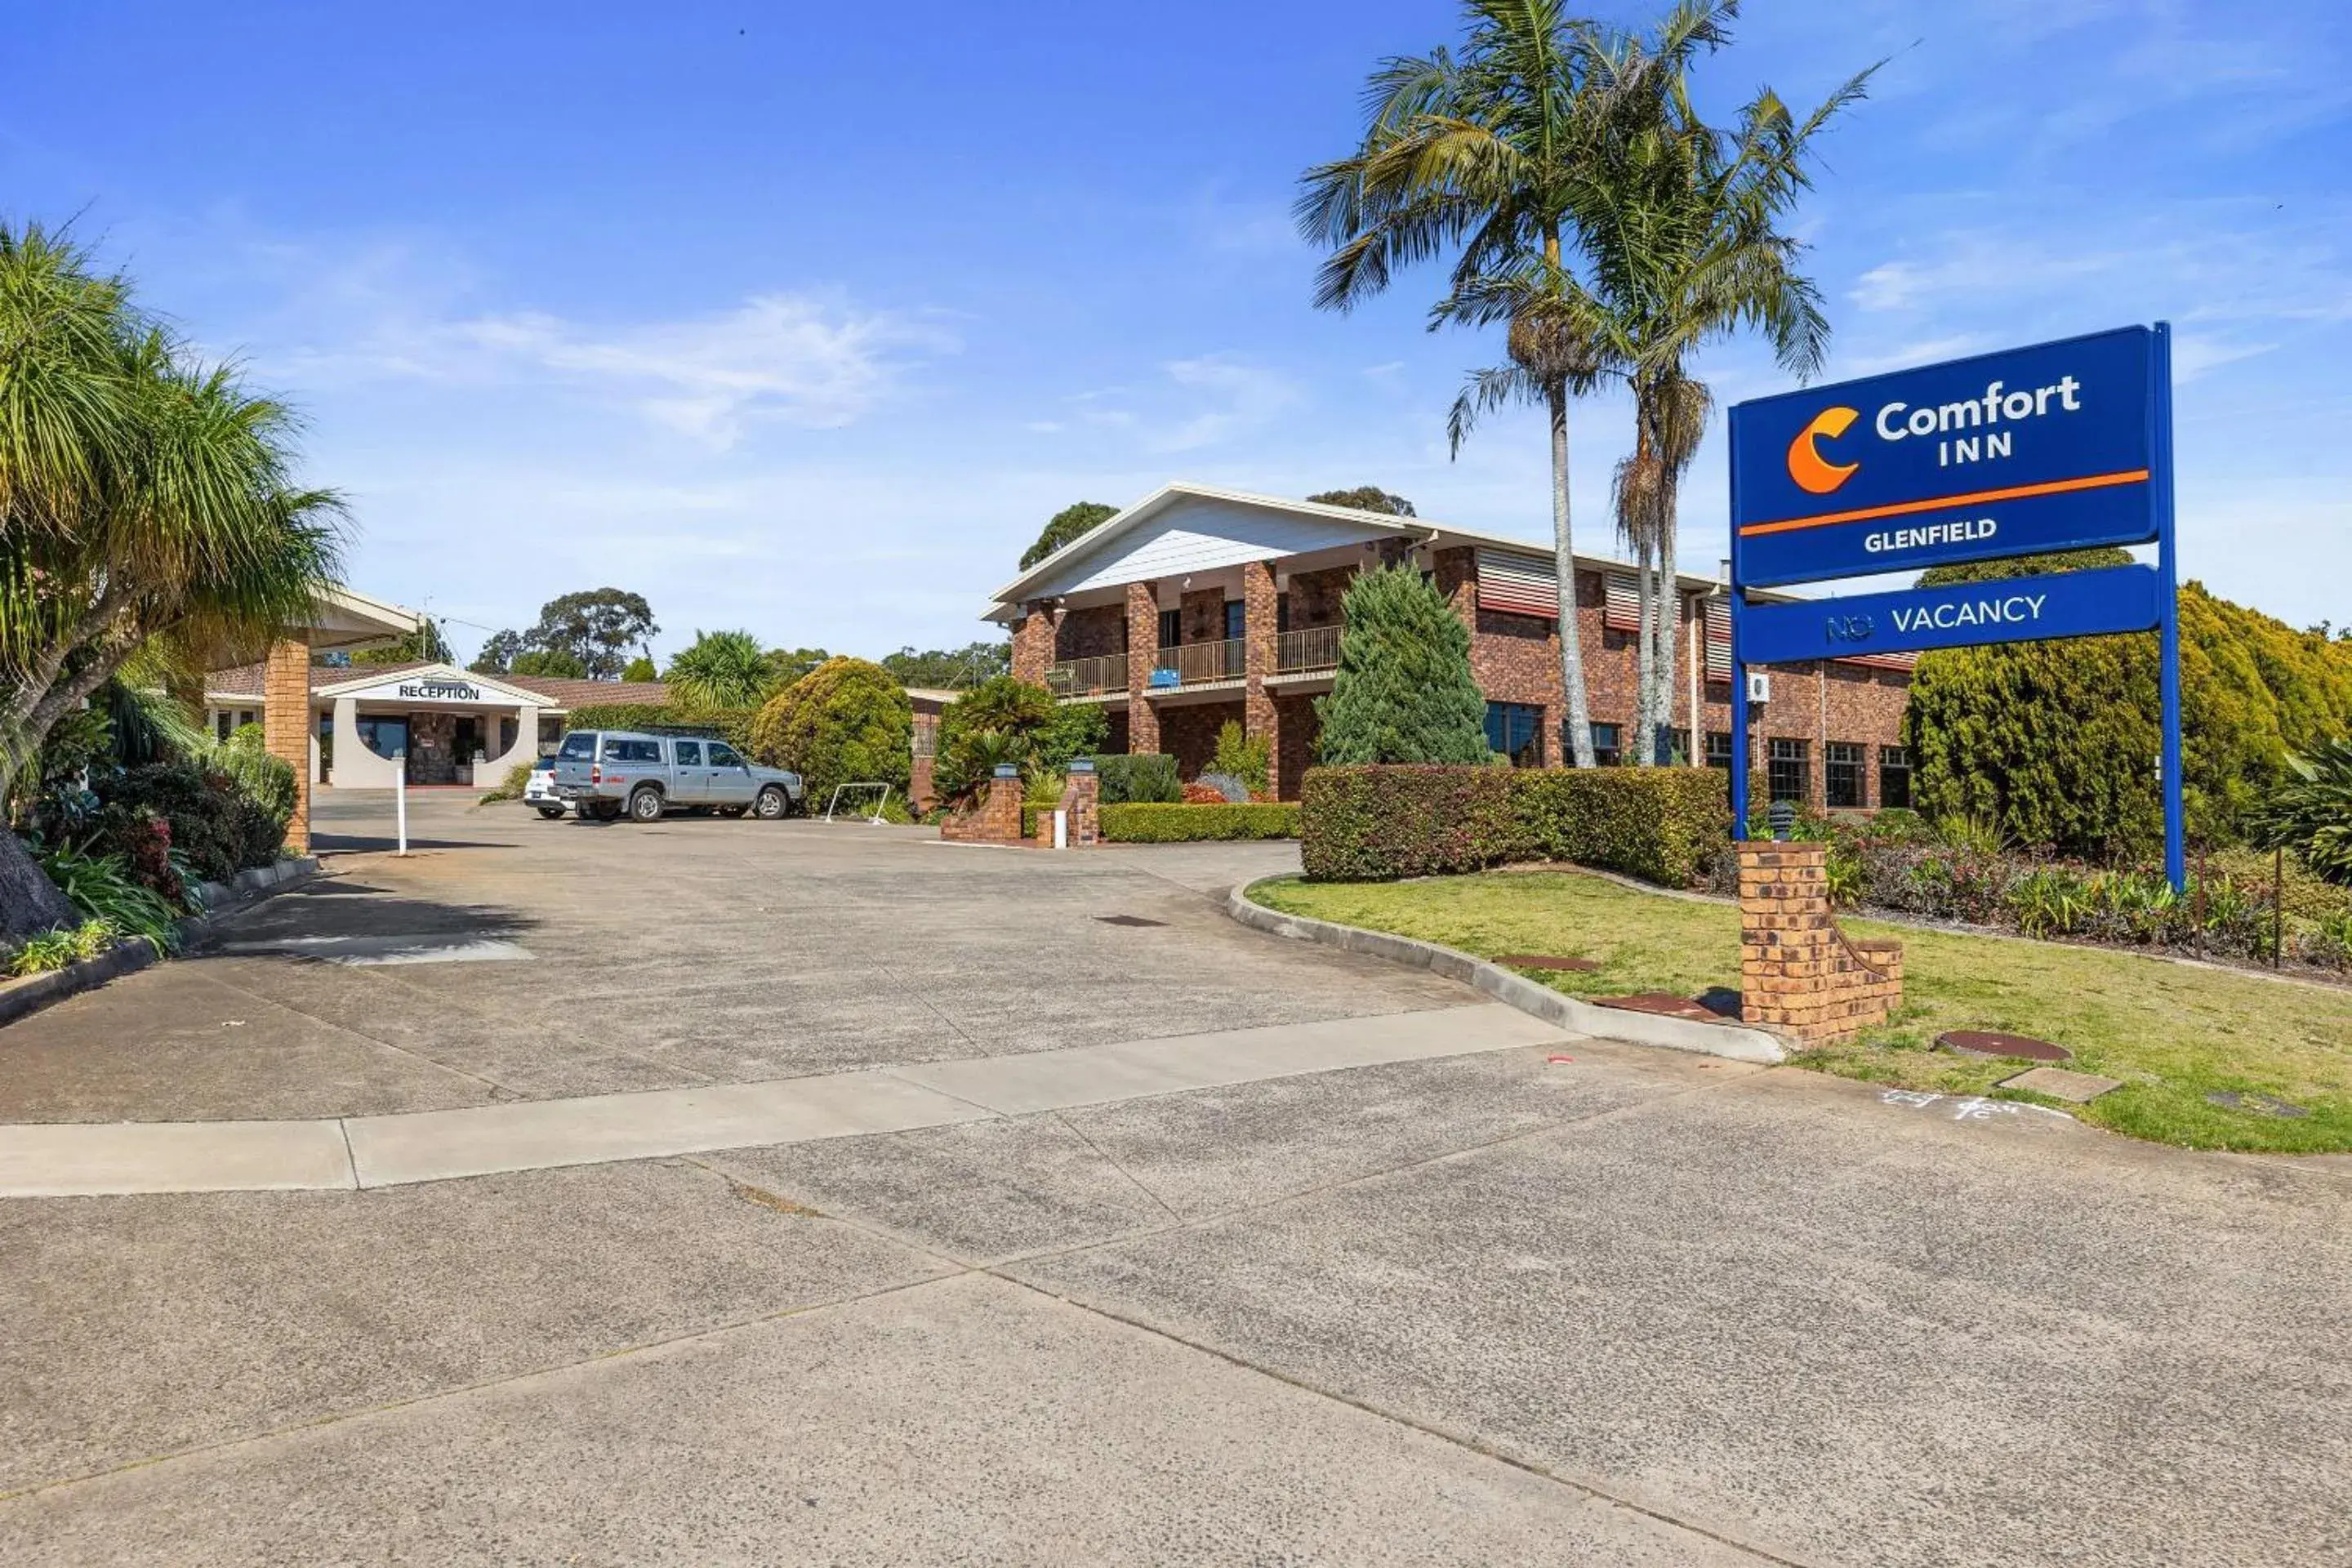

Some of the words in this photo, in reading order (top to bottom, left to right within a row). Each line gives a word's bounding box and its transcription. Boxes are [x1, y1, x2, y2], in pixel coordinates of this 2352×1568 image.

[1876, 376, 2081, 441] Comfort
[1940, 431, 2011, 467] INN
[1864, 519, 1998, 553] GLENFIELD
[1891, 595, 2047, 633] VACANCY
[399, 684, 480, 701] RECEPTION
